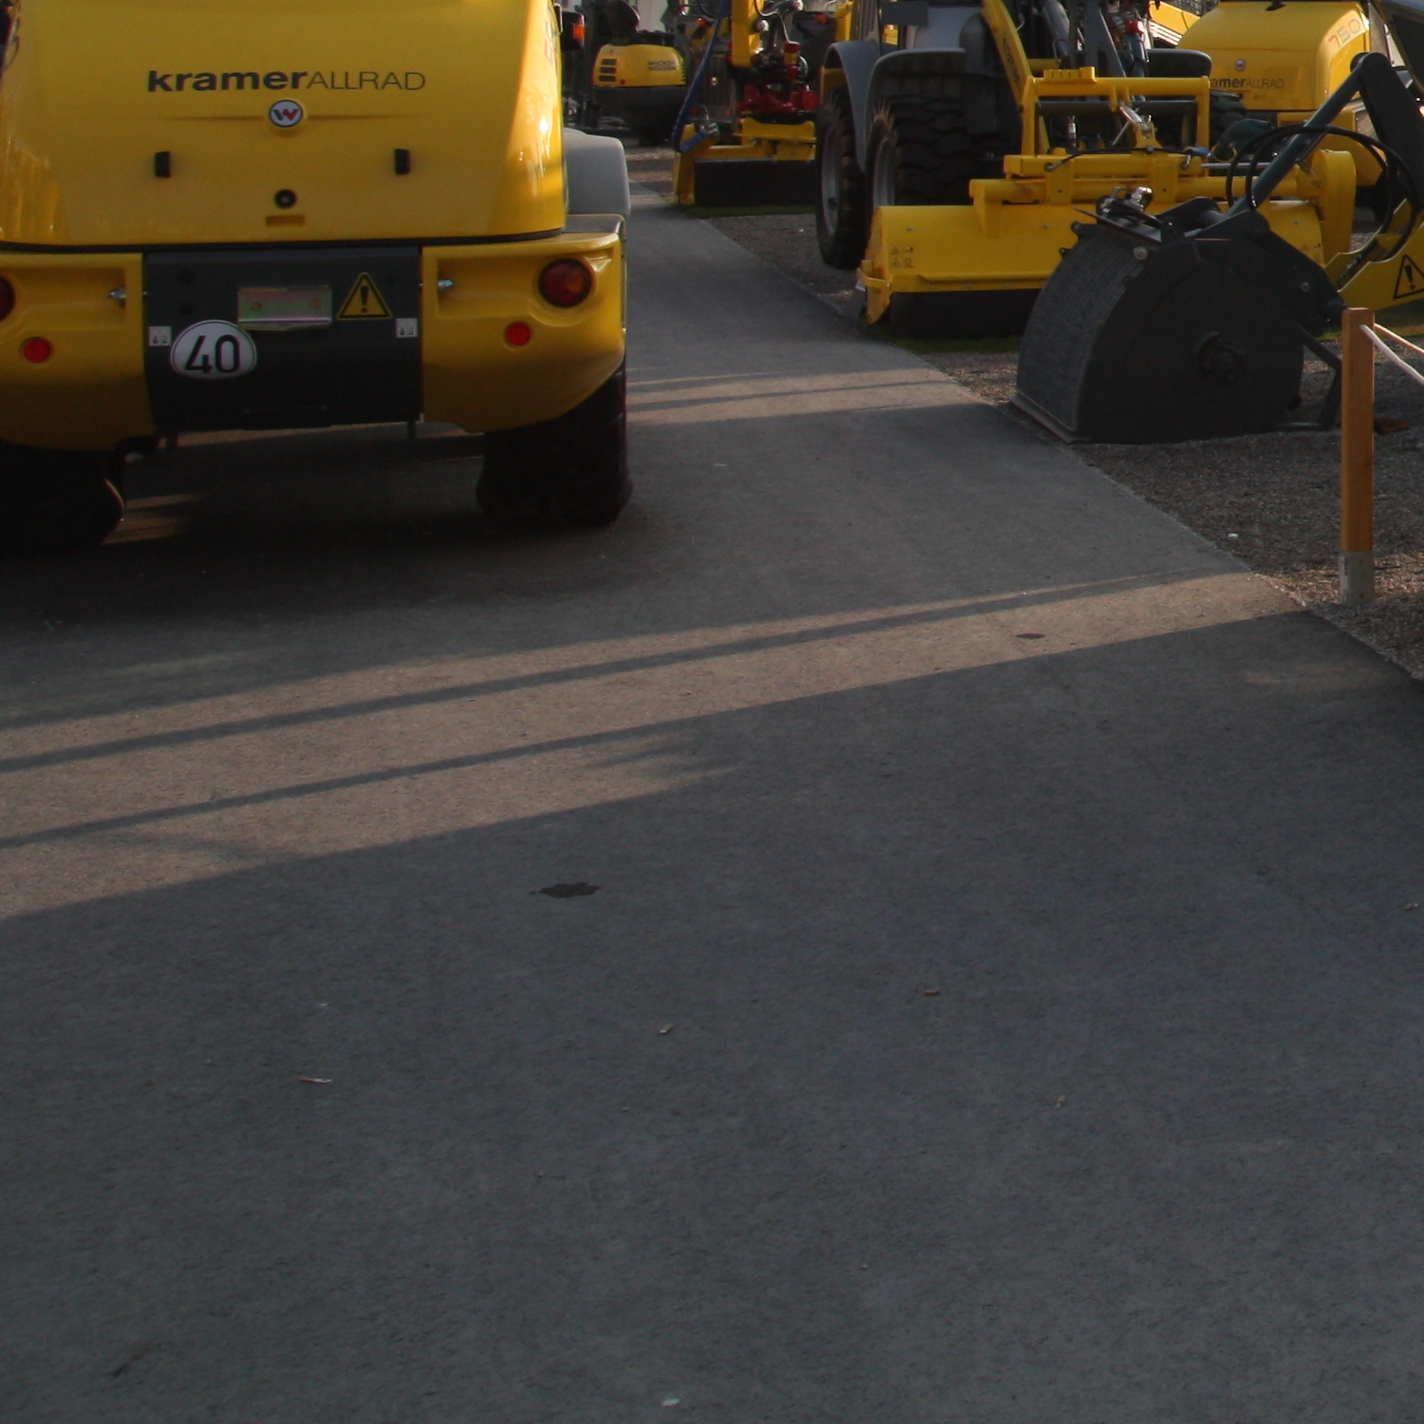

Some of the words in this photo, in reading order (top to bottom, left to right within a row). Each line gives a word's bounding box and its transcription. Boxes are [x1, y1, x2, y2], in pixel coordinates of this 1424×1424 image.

[146, 67, 427, 94] kramerALLRAD
[1210, 74, 1285, 90] amerALLRAD
[183, 334, 241, 376] 40
